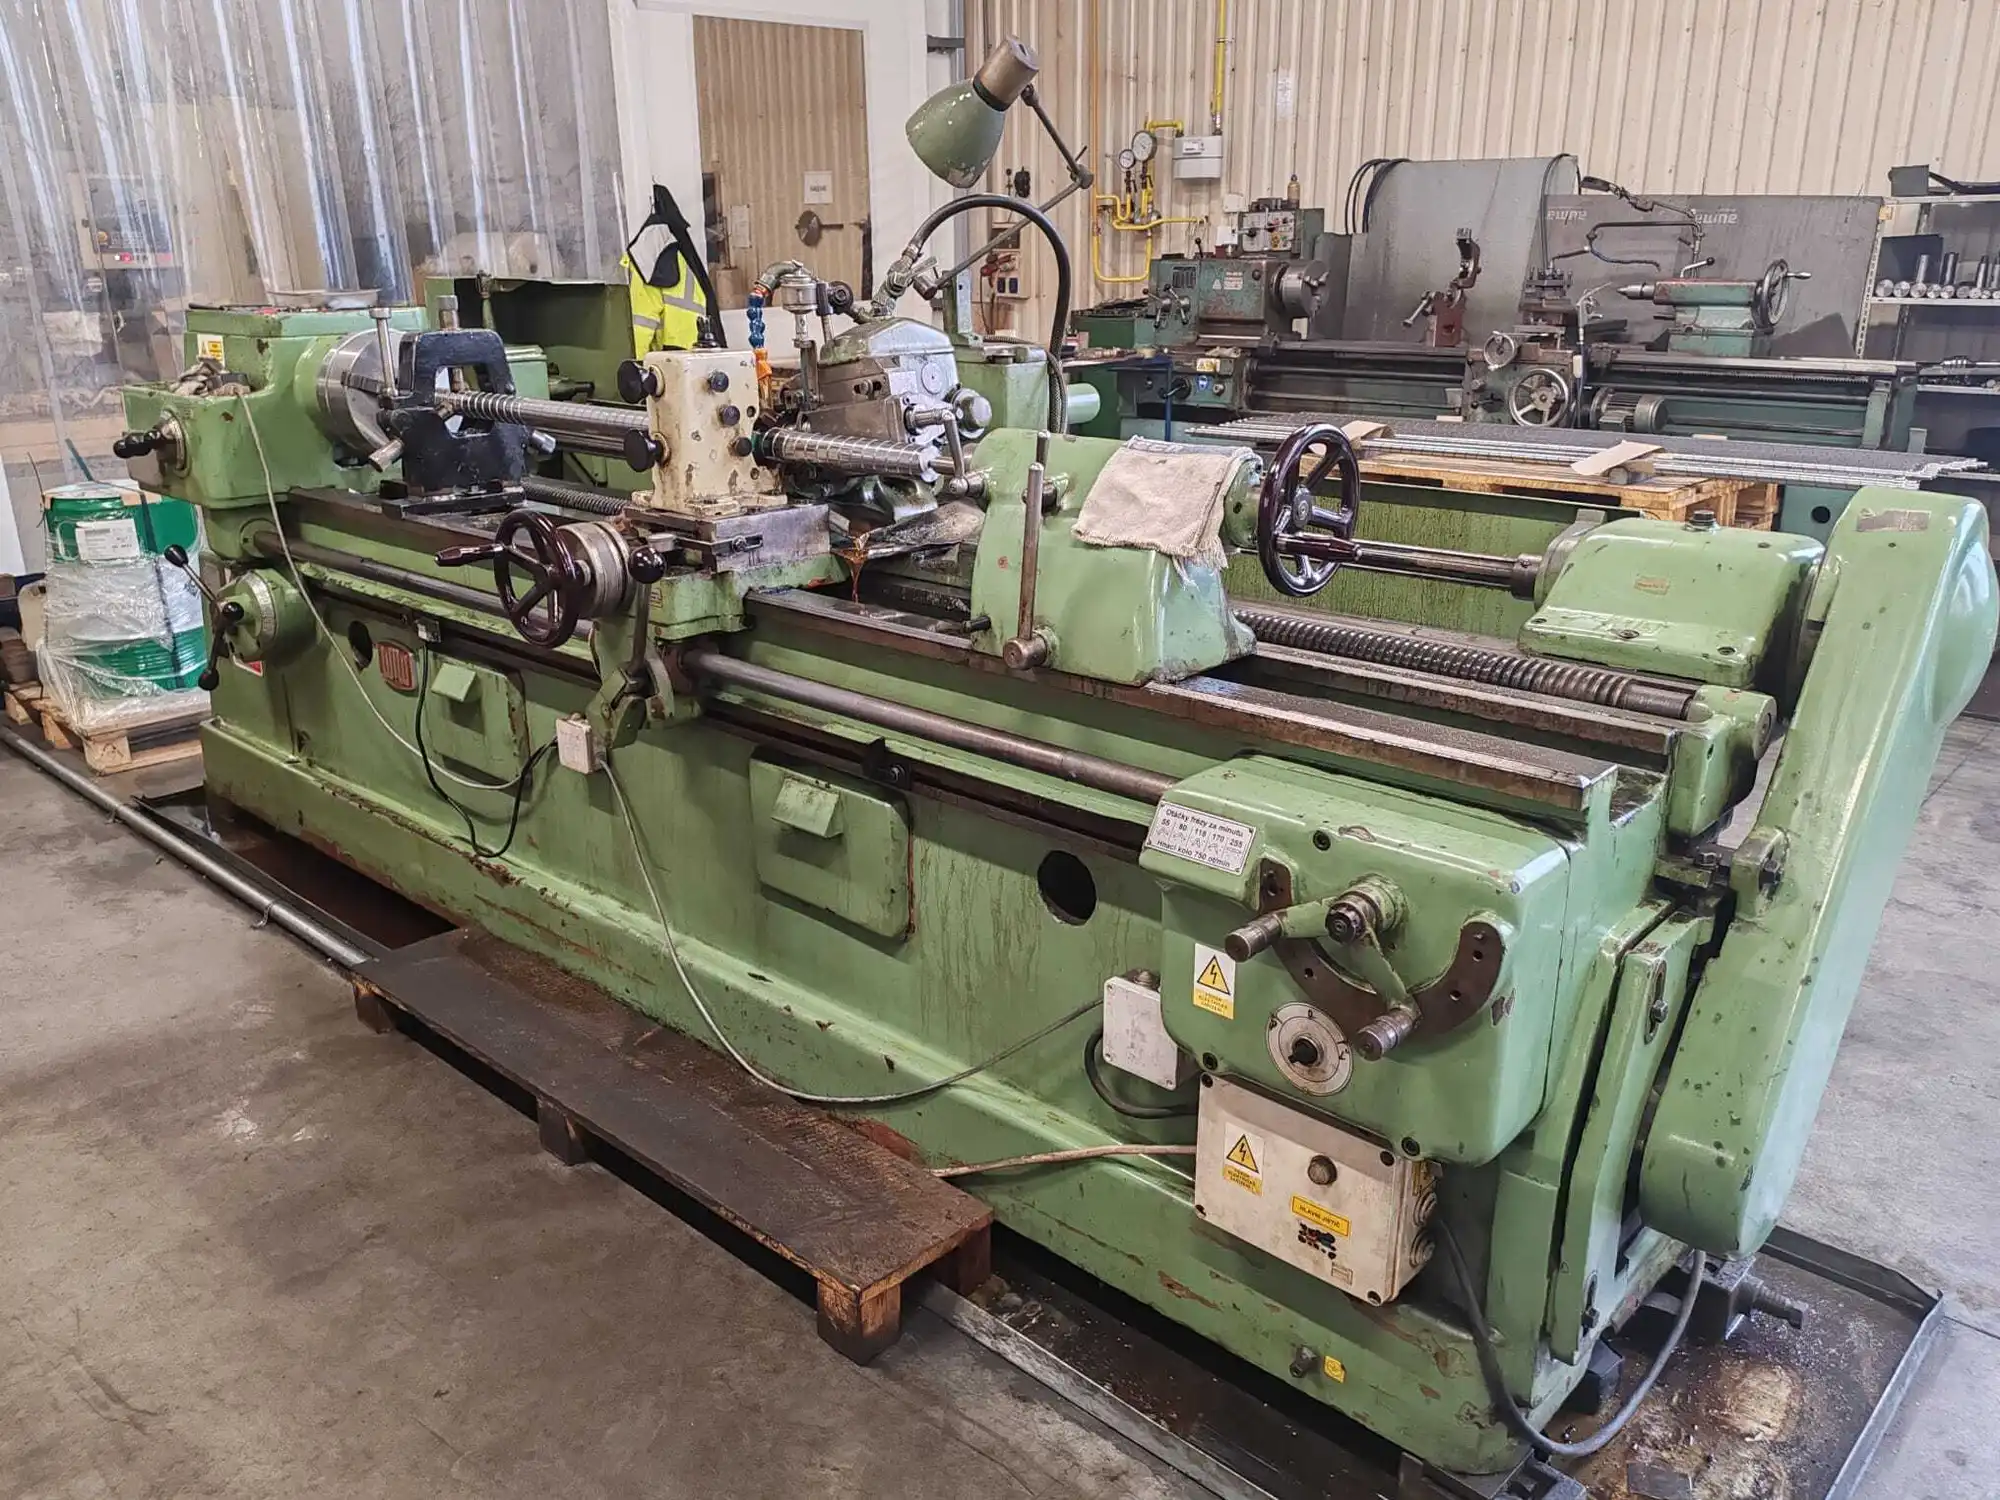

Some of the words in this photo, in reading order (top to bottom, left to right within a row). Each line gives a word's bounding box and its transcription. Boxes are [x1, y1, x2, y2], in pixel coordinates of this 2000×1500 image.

[1162, 818, 1170, 826] 55
[1178, 823, 1187, 831] 80
[1212, 832, 1225, 842] 170
[1230, 837, 1243, 848] 255
[1166, 808, 1188, 821] Otáčky
[1190, 816, 1207, 827] frézy
[1219, 824, 1243, 837] minutu
[1177, 846, 1193, 857] kolo
[1194, 850, 1207, 860] 750
